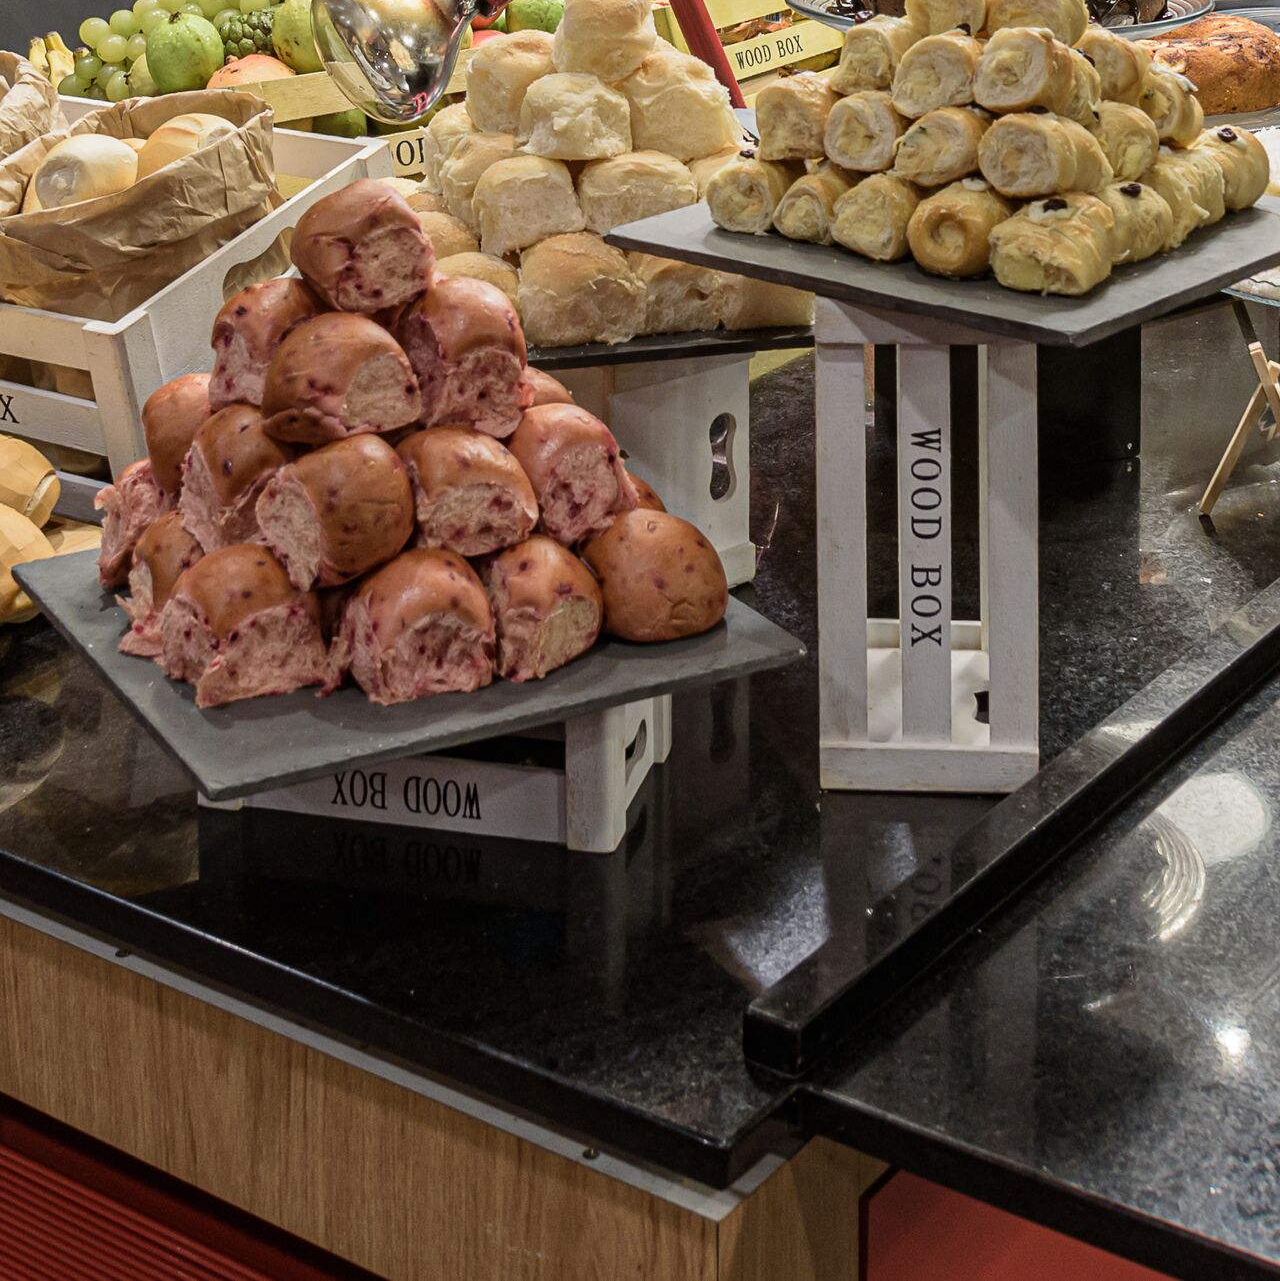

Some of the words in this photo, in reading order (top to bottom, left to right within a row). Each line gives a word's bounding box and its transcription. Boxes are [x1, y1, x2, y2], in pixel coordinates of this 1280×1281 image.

[735, 44, 772, 70] WOOD
[775, 34, 804, 59] BOX
[910, 427, 942, 540] WOOD
[910, 564, 942, 648] BOX
[331, 769, 388, 810] BOX
[403, 775, 482, 820] WOOD
